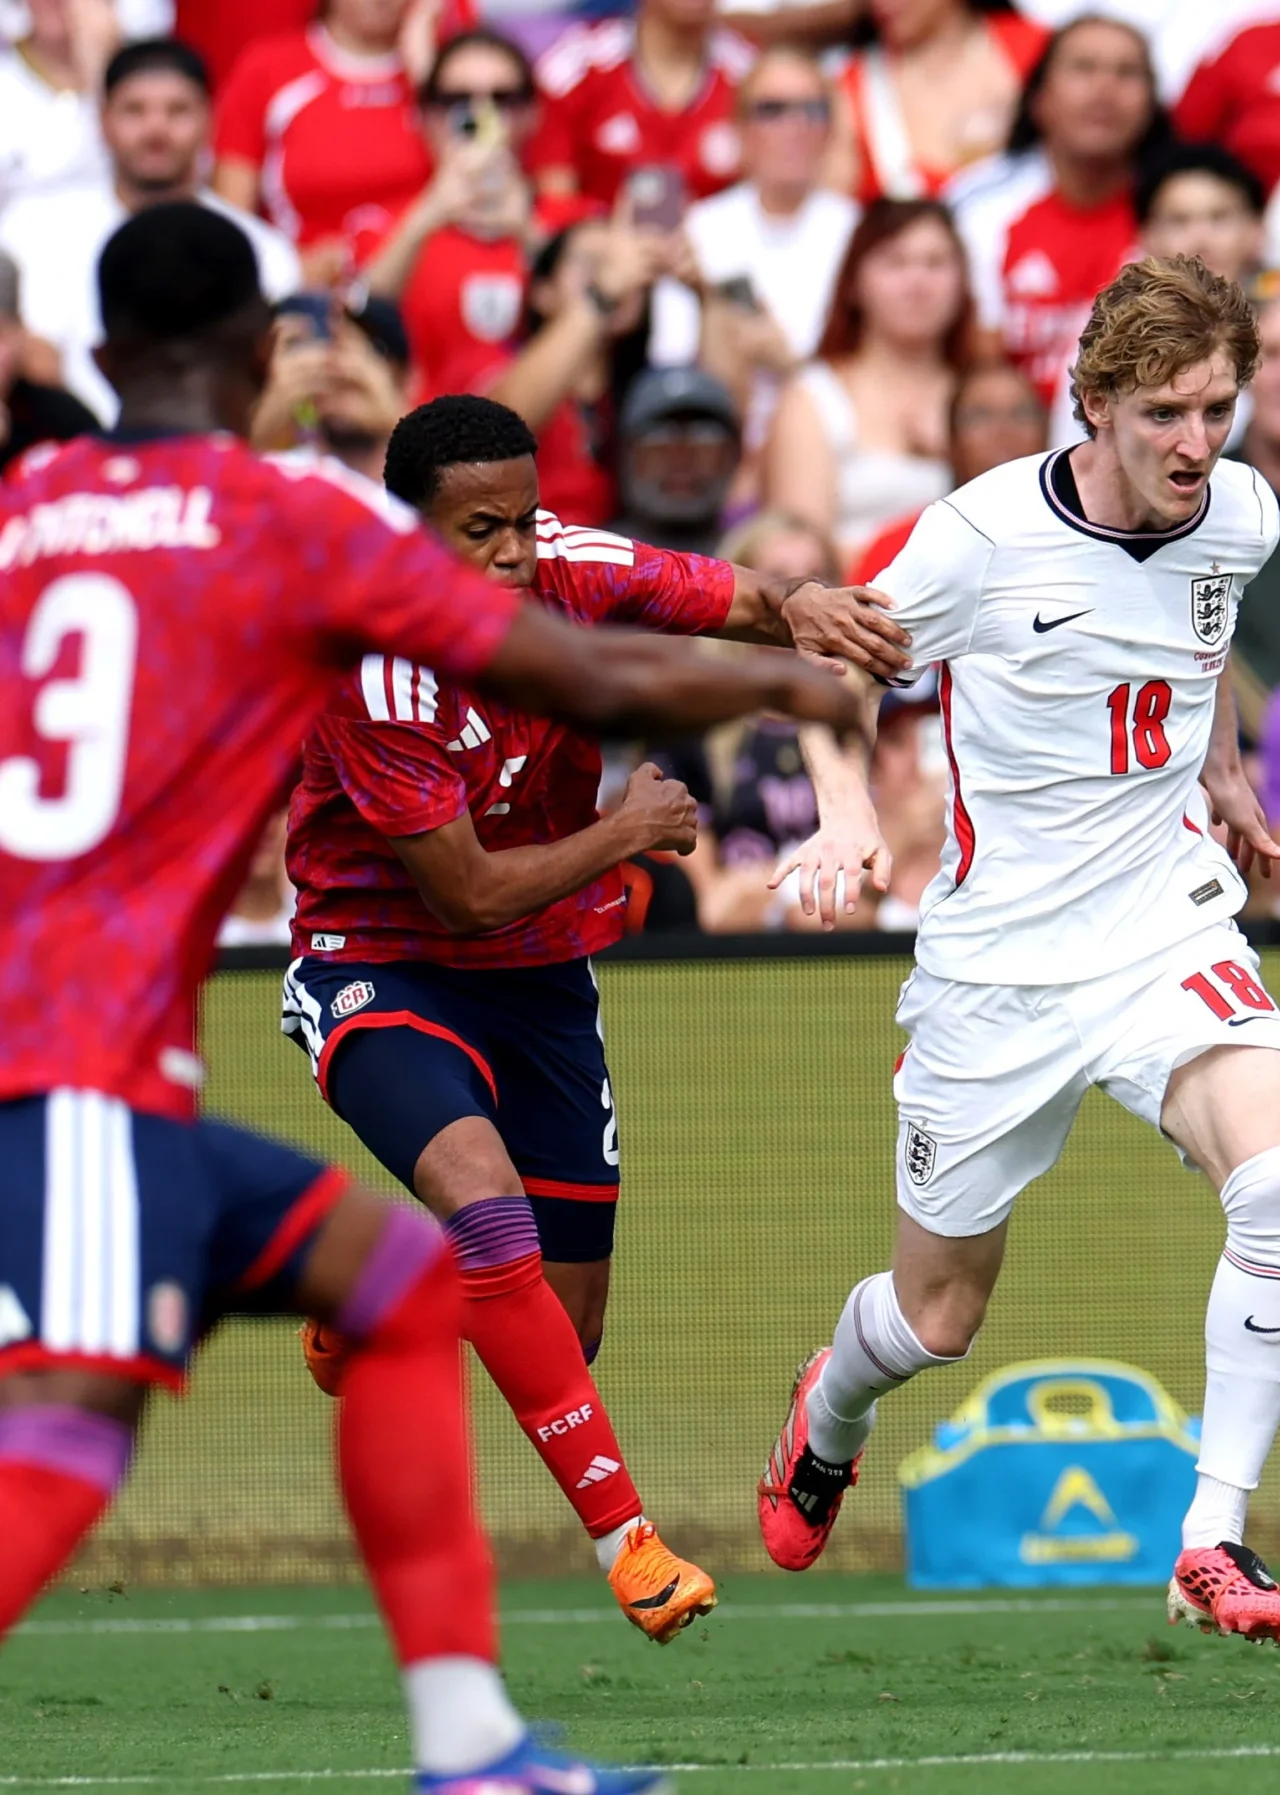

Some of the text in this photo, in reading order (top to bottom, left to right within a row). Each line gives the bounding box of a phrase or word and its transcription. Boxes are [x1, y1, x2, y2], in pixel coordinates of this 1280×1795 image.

[0, 571, 139, 862] 3
[1106, 679, 1172, 775] 18
[341, 987, 365, 1010] CR
[1180, 960, 1275, 1021] 18
[537, 1403, 593, 1442] FCRF
